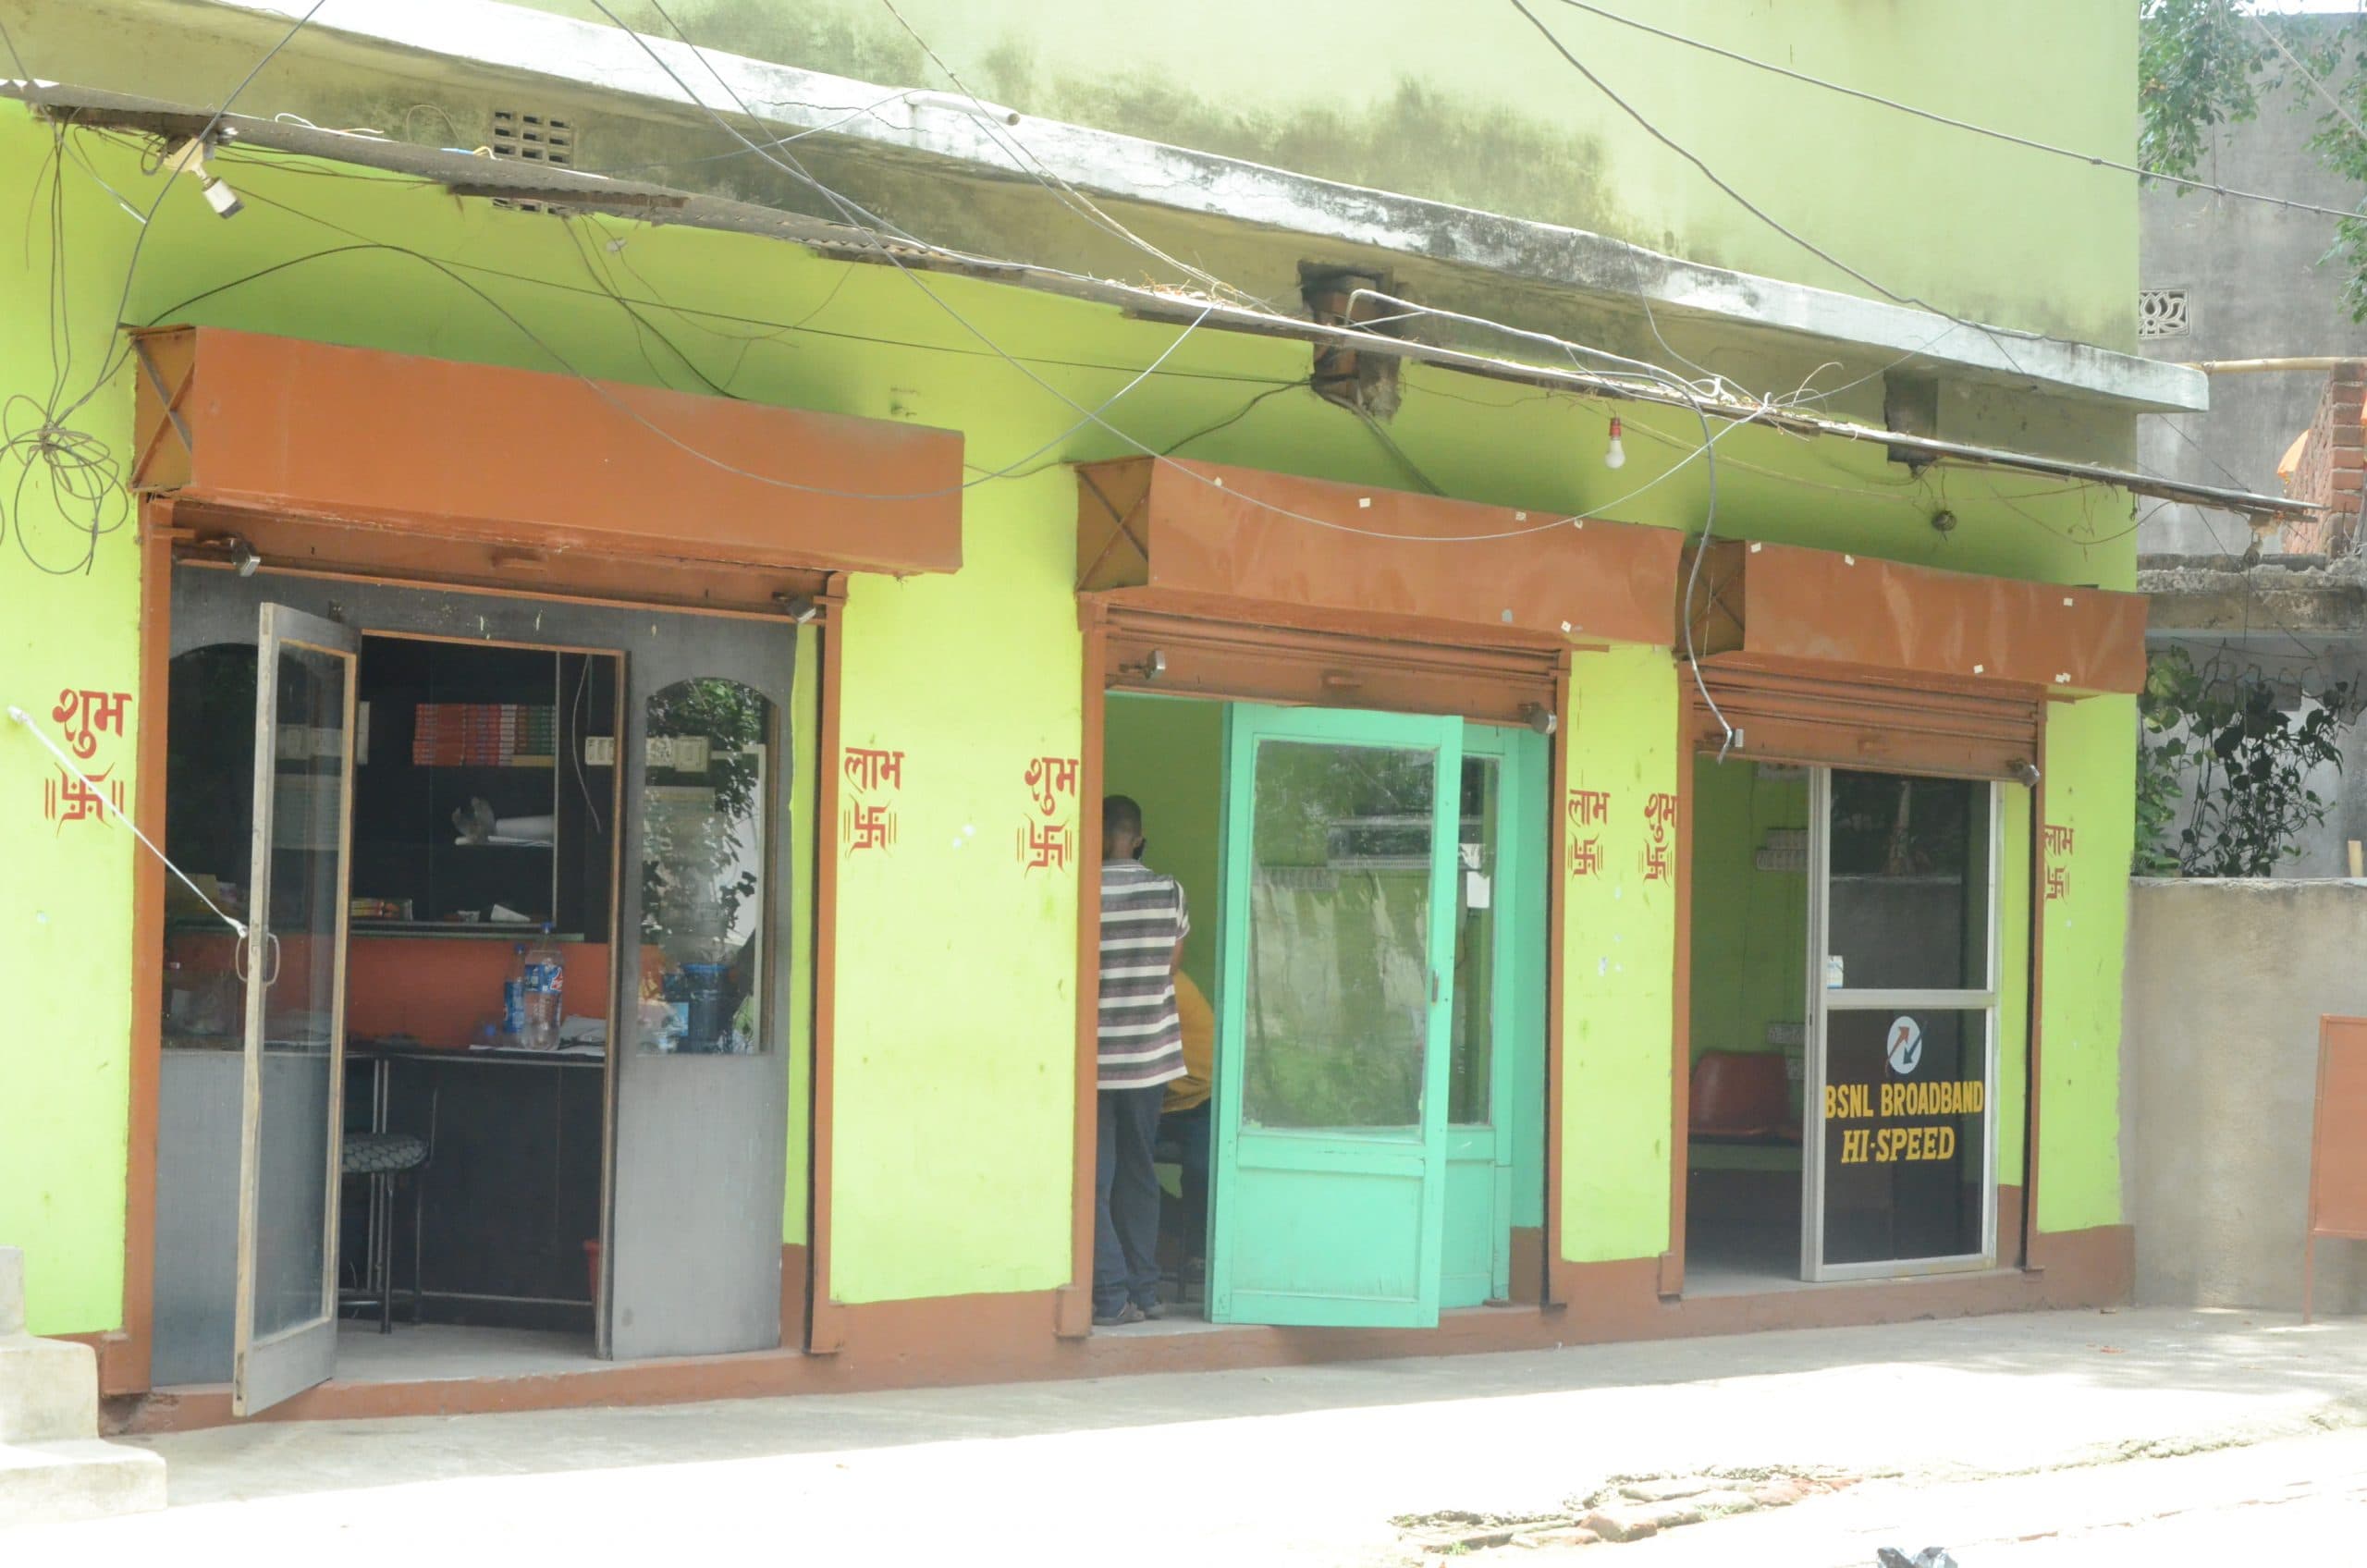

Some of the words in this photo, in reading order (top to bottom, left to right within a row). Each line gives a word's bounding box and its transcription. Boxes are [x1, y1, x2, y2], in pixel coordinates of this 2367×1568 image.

[52, 688, 132, 759] शुभ
[843, 747, 905, 793] लाभ
[1024, 756, 1079, 816] शुभ
[1568, 789, 1611, 827] लाभ
[1644, 793, 1680, 843] शुभ
[1824, 1084, 1874, 1119] BSNL
[1881, 1080, 1984, 1117] BROADBAND
